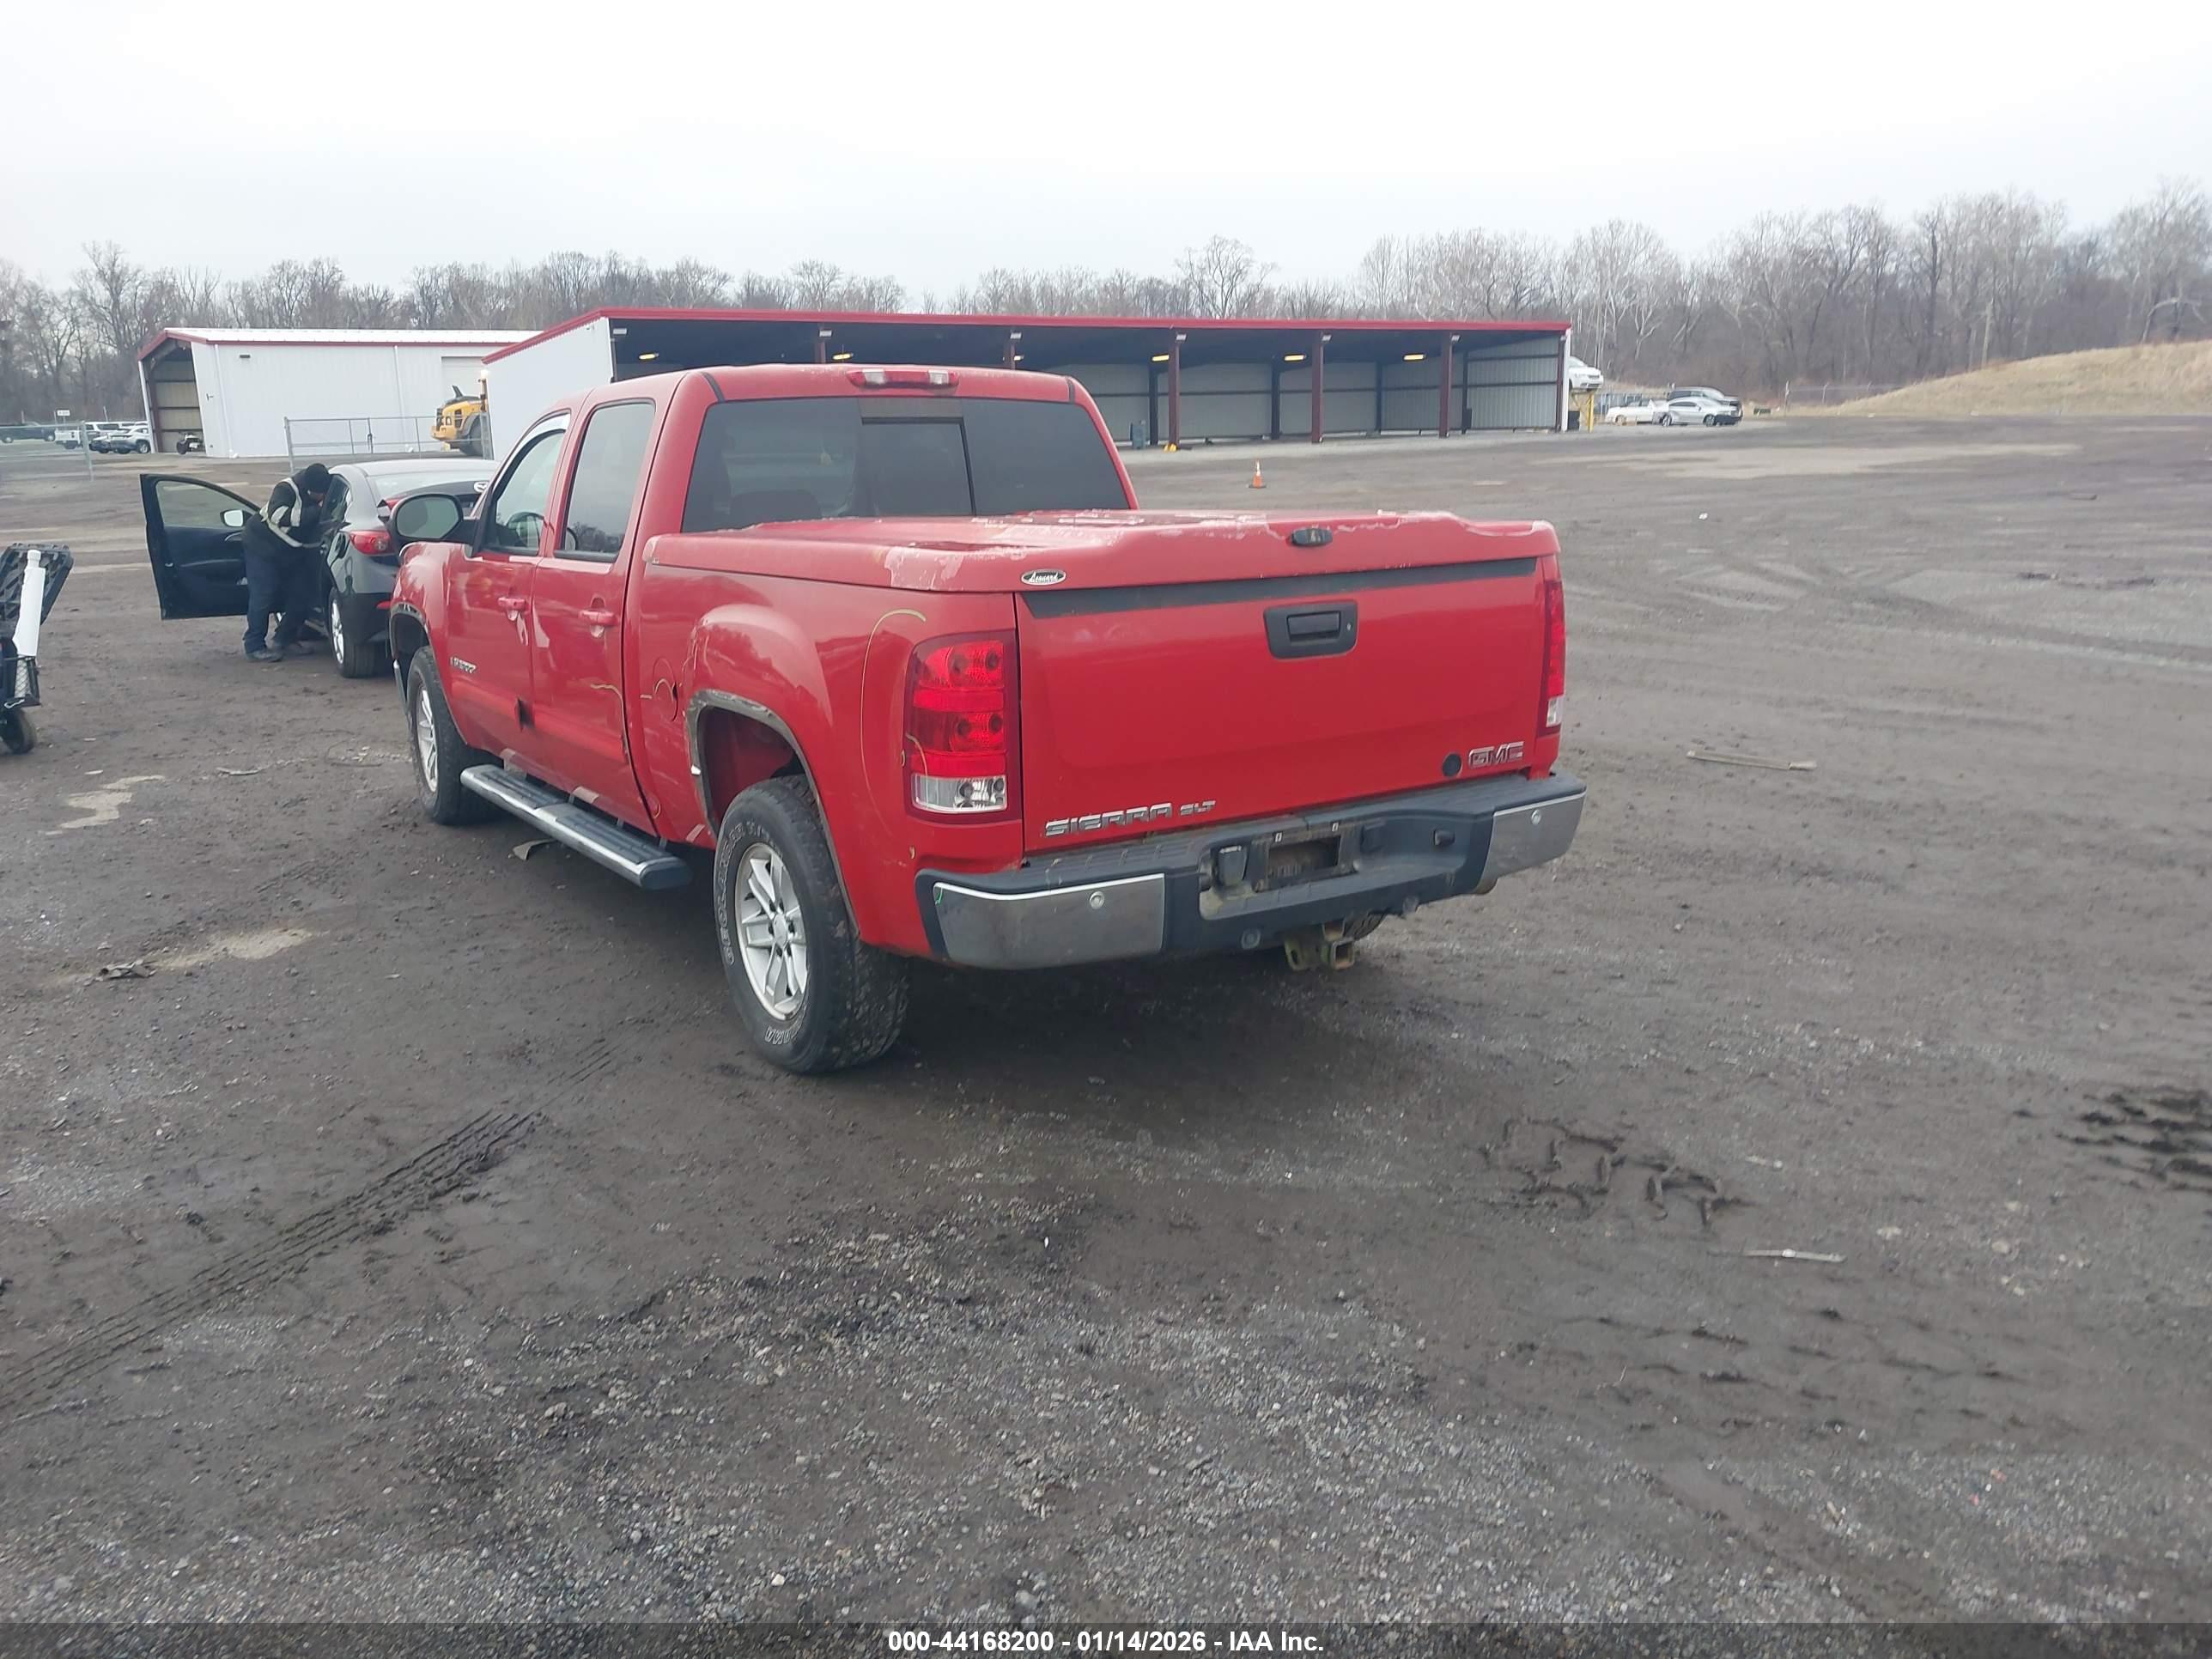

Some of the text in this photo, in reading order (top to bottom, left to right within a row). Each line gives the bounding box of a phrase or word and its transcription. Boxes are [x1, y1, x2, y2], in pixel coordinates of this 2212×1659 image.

[1468, 741, 1524, 768] GMC
[1045, 799, 1216, 837] SIERRA SLT
